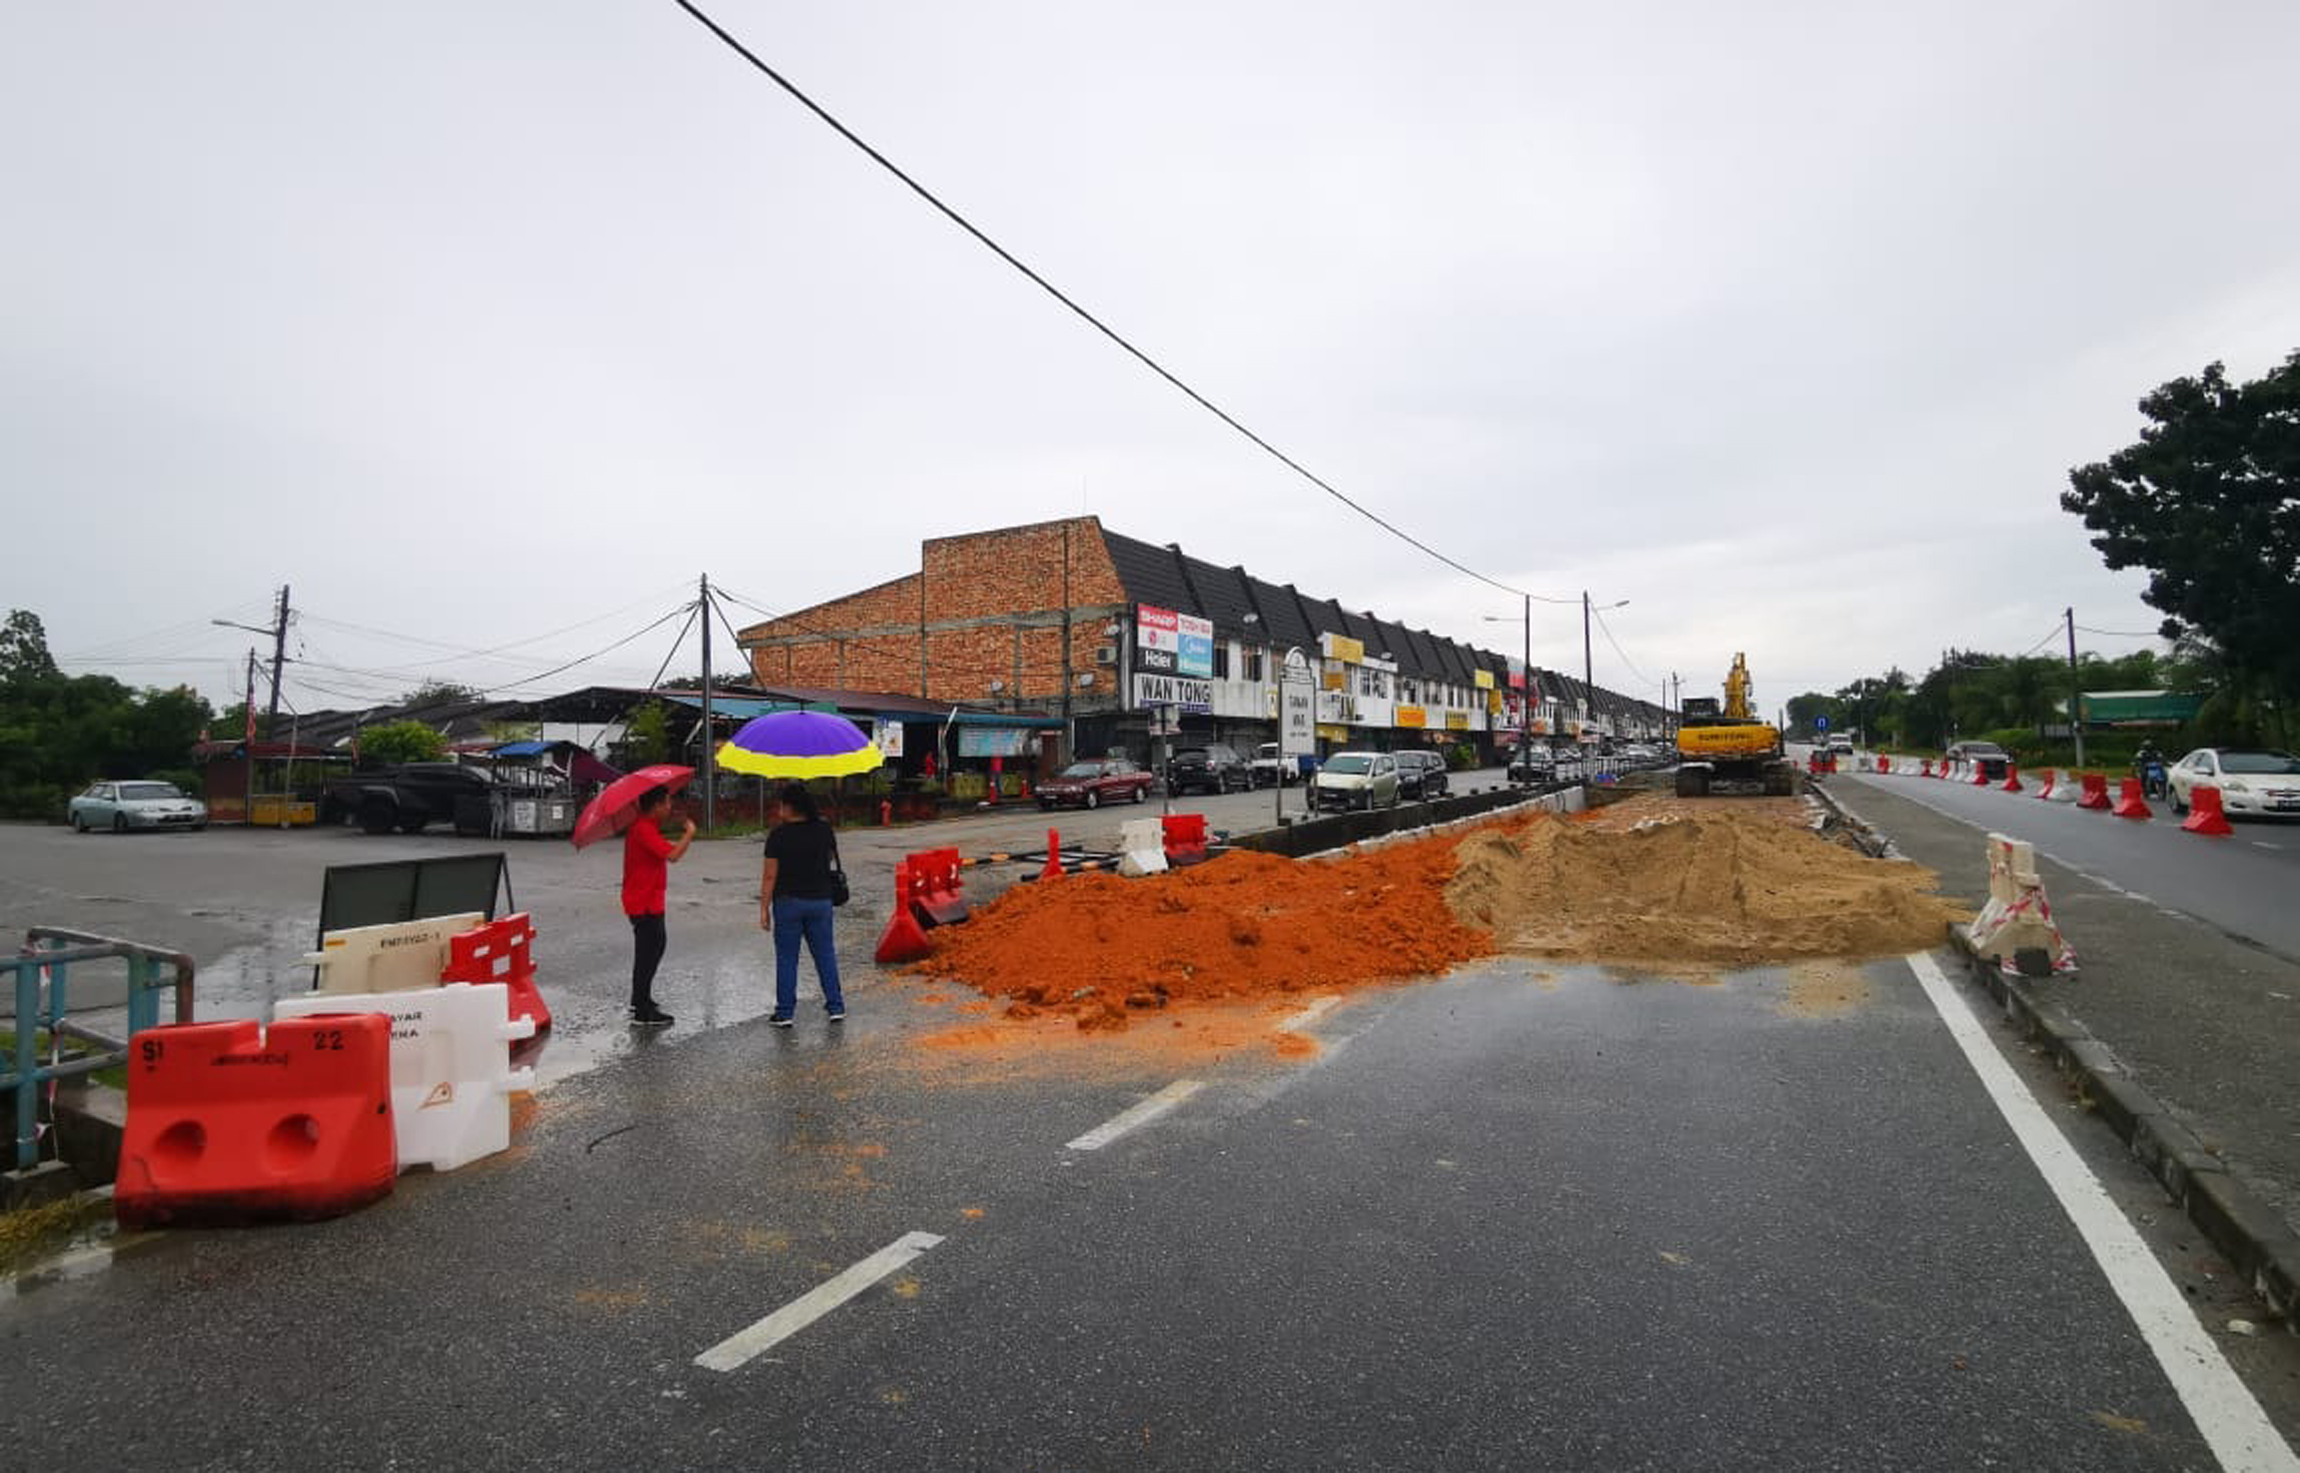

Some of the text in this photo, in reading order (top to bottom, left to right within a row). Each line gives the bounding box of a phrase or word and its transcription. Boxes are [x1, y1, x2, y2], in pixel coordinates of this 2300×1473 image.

[1145, 649, 1172, 668] Haier
[1141, 676, 1212, 704] WAN TONG
[313, 1029, 344, 1051] 22
